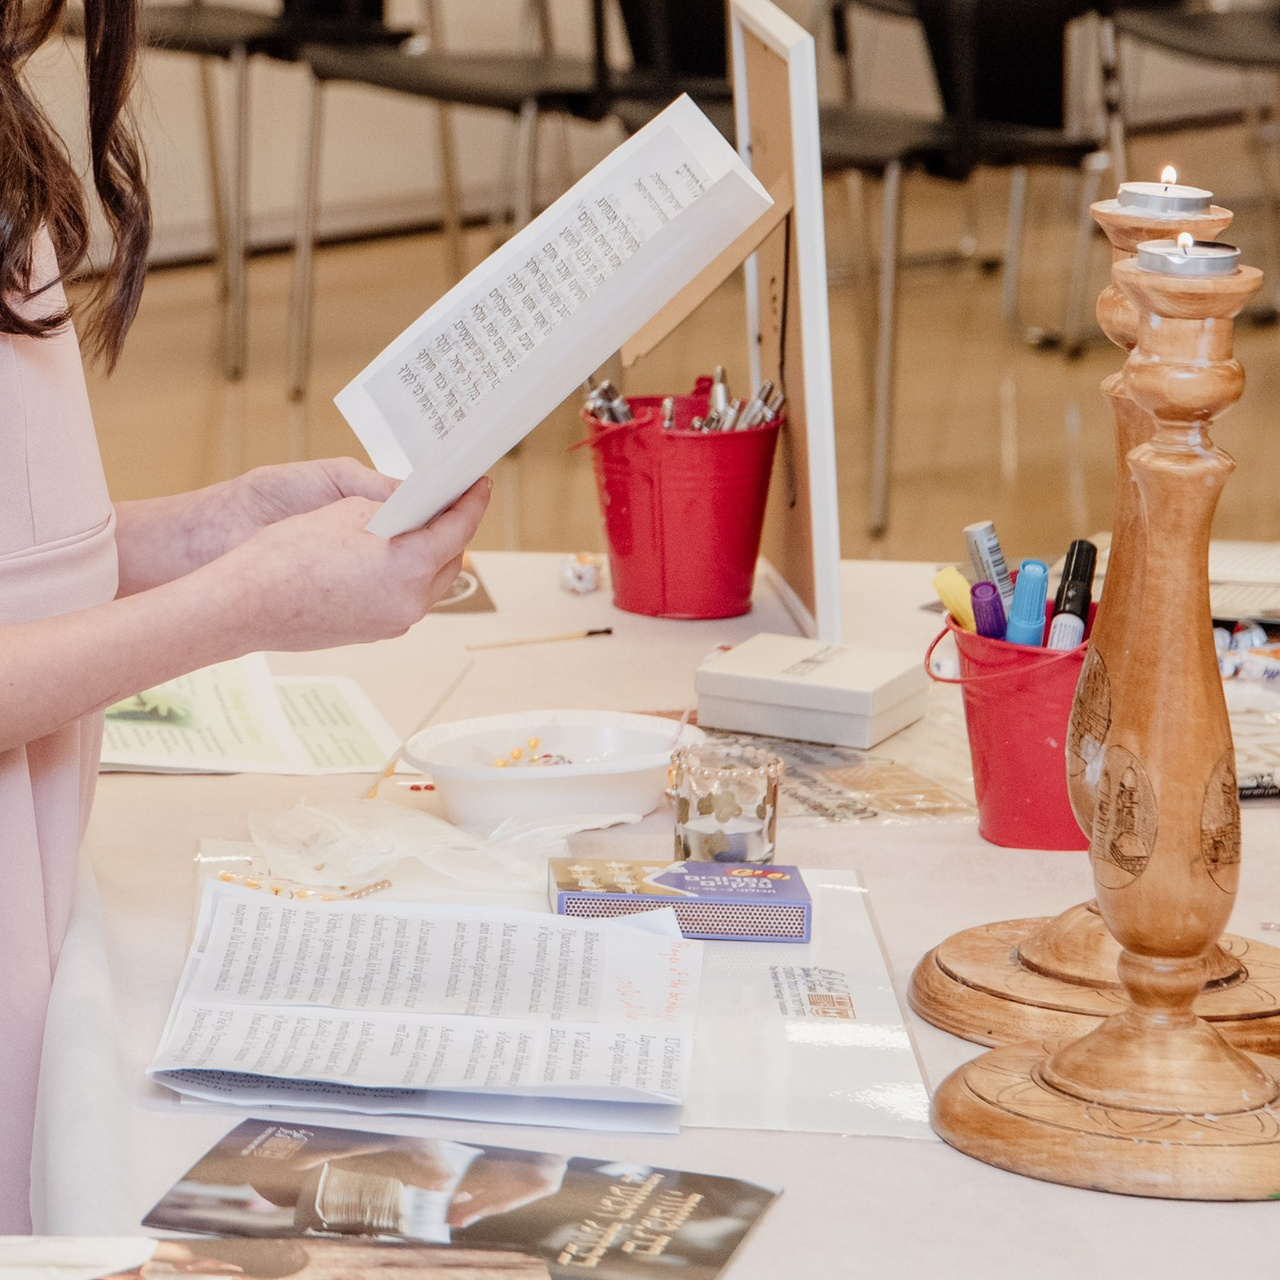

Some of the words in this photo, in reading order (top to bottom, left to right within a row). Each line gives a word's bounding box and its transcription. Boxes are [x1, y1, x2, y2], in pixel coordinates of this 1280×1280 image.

[577, 211, 599, 237] וחזקים
[542, 242, 559, 262] אותם
[523, 257, 541, 277] אותך
[506, 272, 525, 296] לתורה
[488, 288, 512, 318] מוצלחים
[416, 348, 436, 374] תורתך
[397, 362, 418, 387] לפניך
[411, 381, 425, 397] לבי
